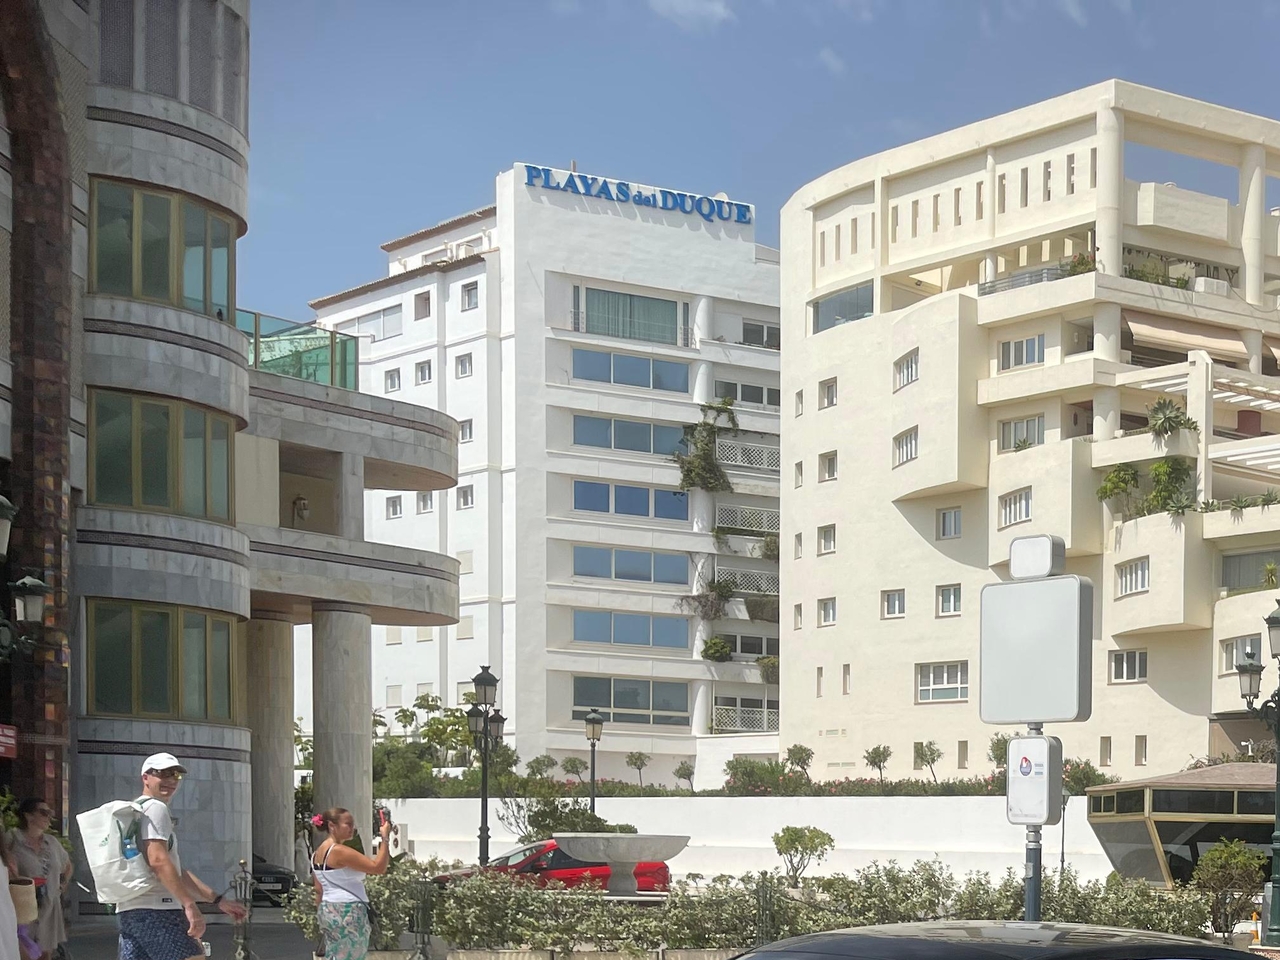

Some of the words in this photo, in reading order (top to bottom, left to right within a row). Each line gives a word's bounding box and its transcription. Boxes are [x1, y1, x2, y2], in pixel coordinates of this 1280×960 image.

[524, 164, 630, 203] PLAYAS
[632, 190, 657, 208] del
[659, 189, 752, 225] DUQUE
